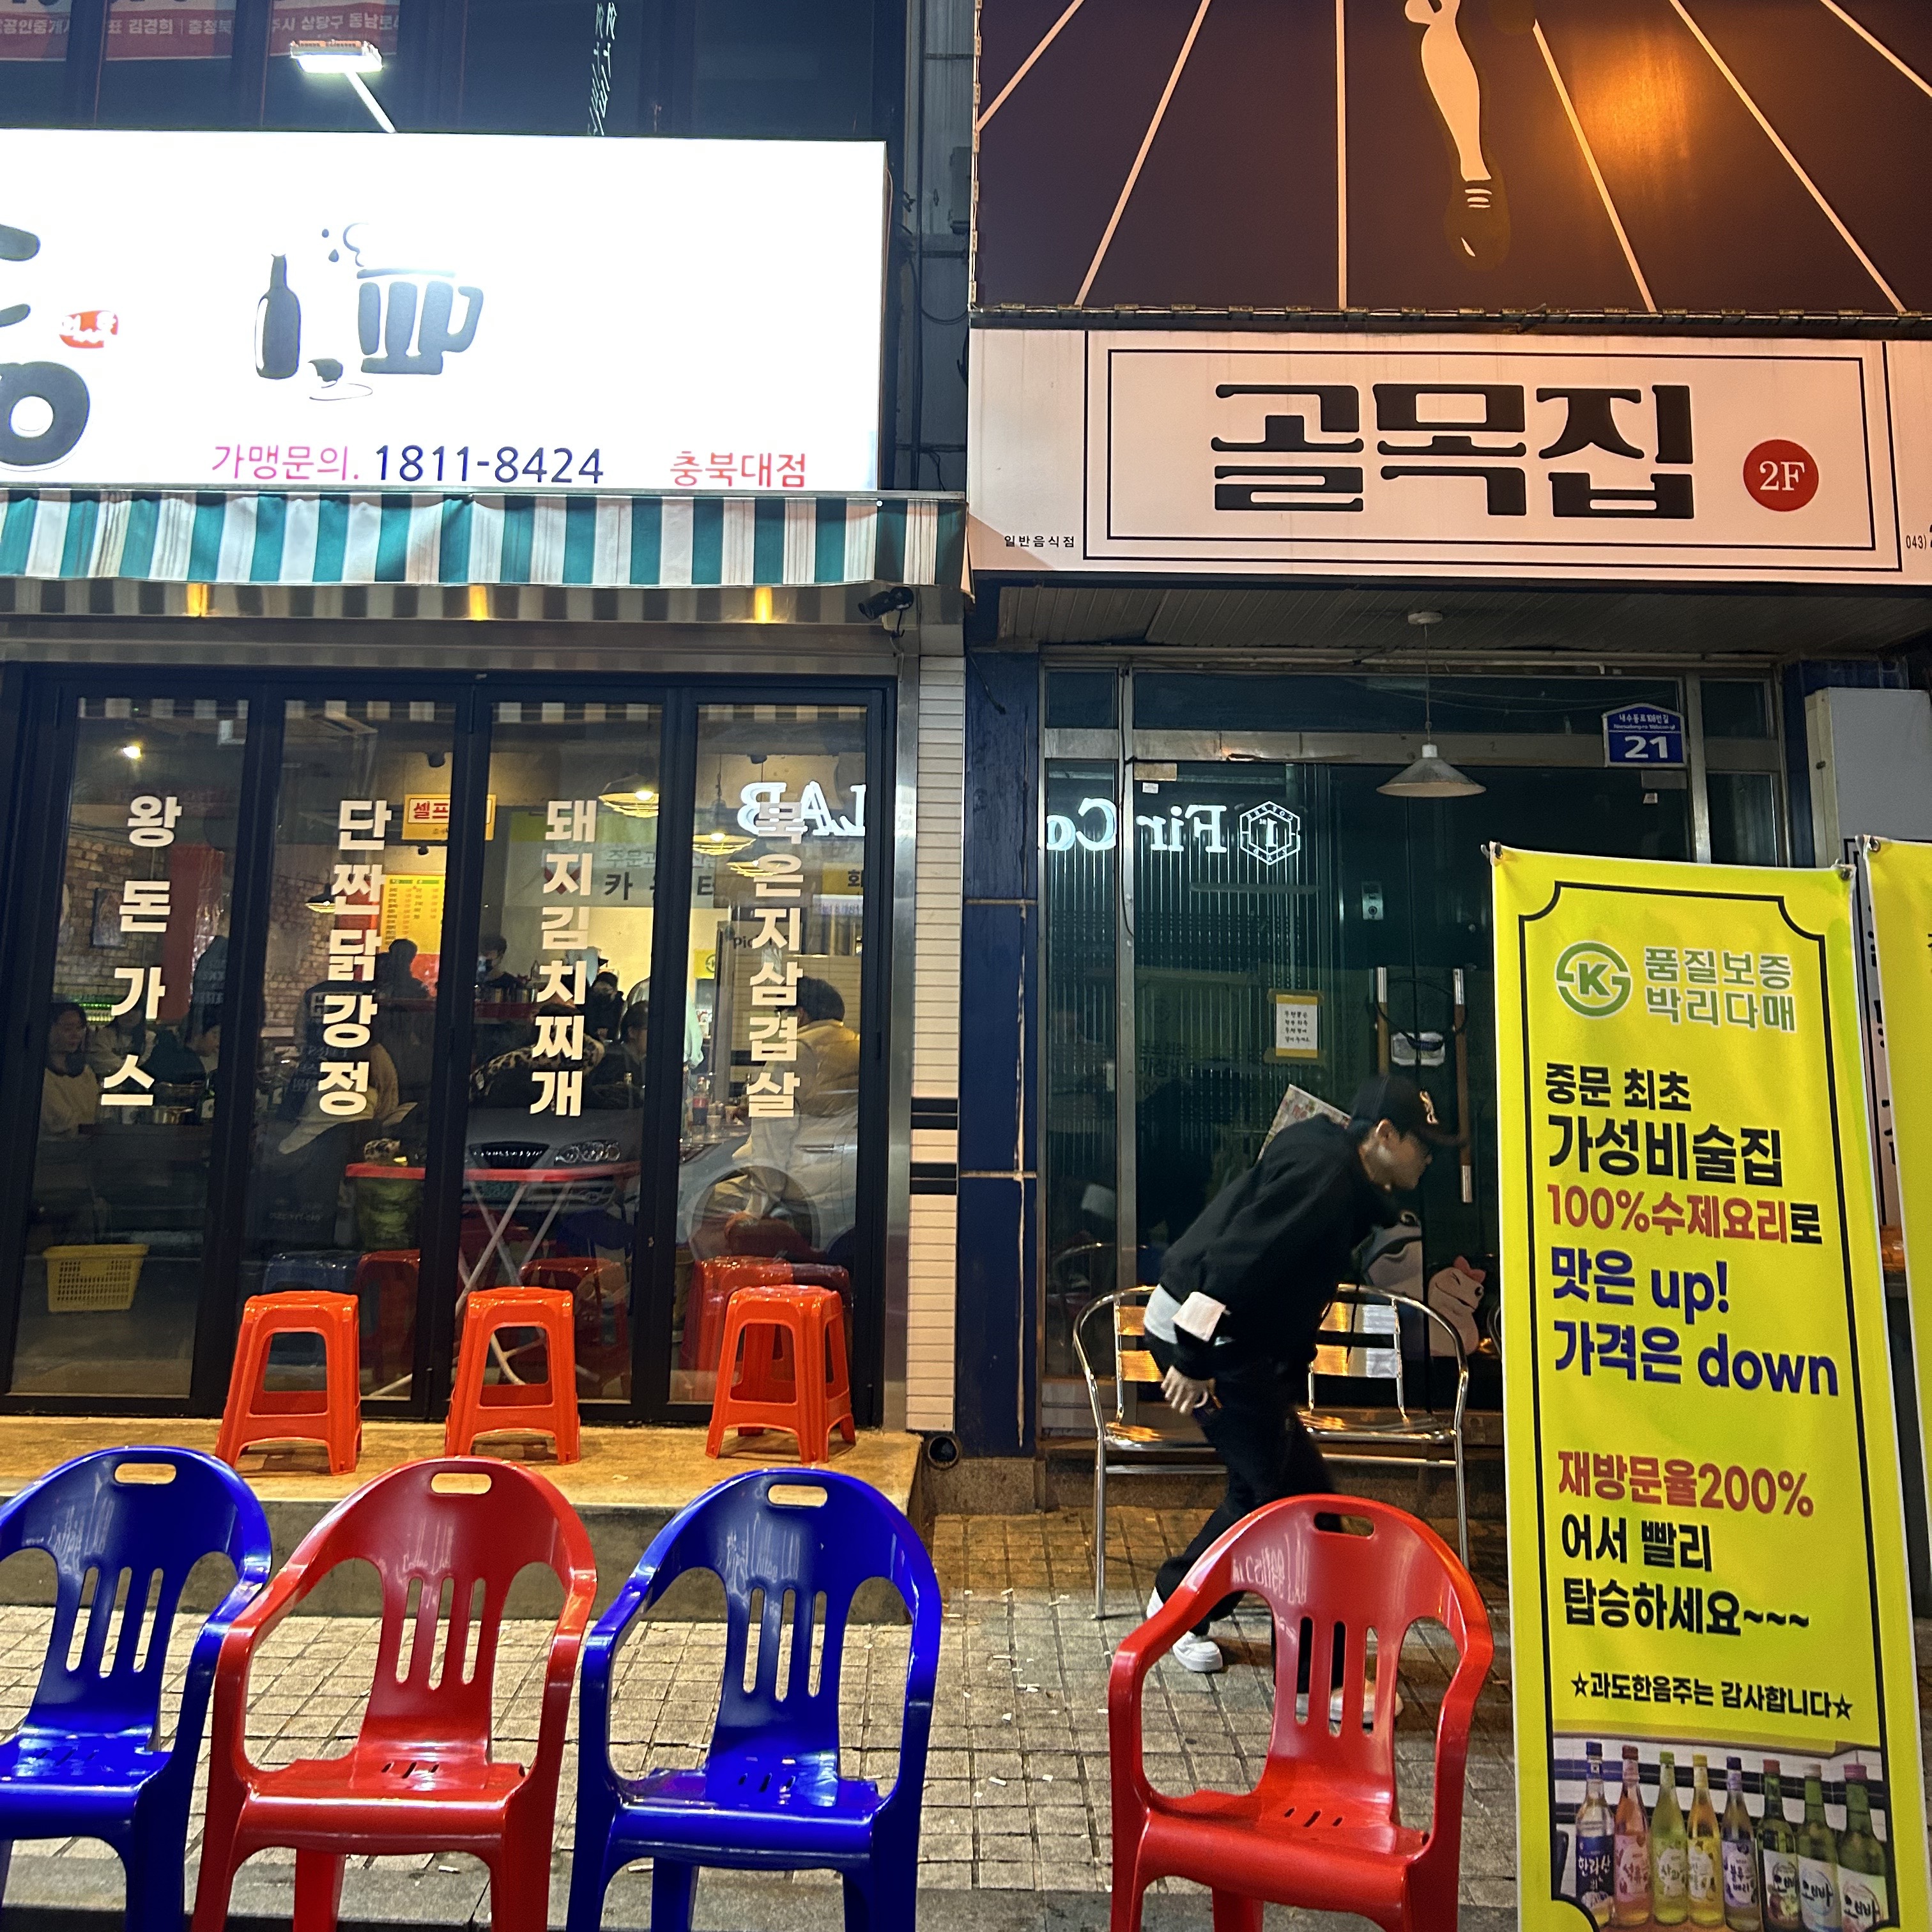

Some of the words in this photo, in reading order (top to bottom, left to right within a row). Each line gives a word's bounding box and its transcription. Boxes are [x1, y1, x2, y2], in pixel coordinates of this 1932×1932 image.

[130, 19, 173, 35] 김경희
[302, 15, 343, 31] 상당구
[211, 444, 359, 480] 가맹문의.
[376, 443, 604, 484] 1811-8424
[670, 450, 806, 487] 충북대점
[1211, 383, 1694, 519] 골목집
[1759, 461, 1804, 491] 2F
[1004, 535, 1076, 549] 일반음식점
[1625, 735, 1668, 758] 21
[101, 796, 182, 1107] 왕돈가스
[318, 799, 392, 1116] 단짠닭강정
[530, 799, 598, 1117] 돼지김치찌개
[746, 802, 807, 1118] 묵은지삼겹살
[1644, 947, 1791, 990] 품질보증
[1645, 987, 1797, 1032] 박리다매
[1545, 1062, 1611, 1107] 중문
[1623, 1068, 1692, 1112] 최초
[1547, 1114, 1783, 1187] 가성비술집
[1547, 1184, 1822, 1245] 100%수제요리로
[1551, 1246, 1636, 1306] 맛은
[1650, 1261, 1729, 1325] up!
[1553, 1320, 1683, 1384] 가격은
[1697, 1333, 1839, 1397] down
[1558, 1450, 1814, 1517] 재방문율200%
[1561, 1513, 1628, 1564] 어서
[1641, 1520, 1712, 1572] 빨리
[1563, 1577, 1810, 1636] 탑승하세요~~~
[1578, 1855, 1611, 1878] 한라산
